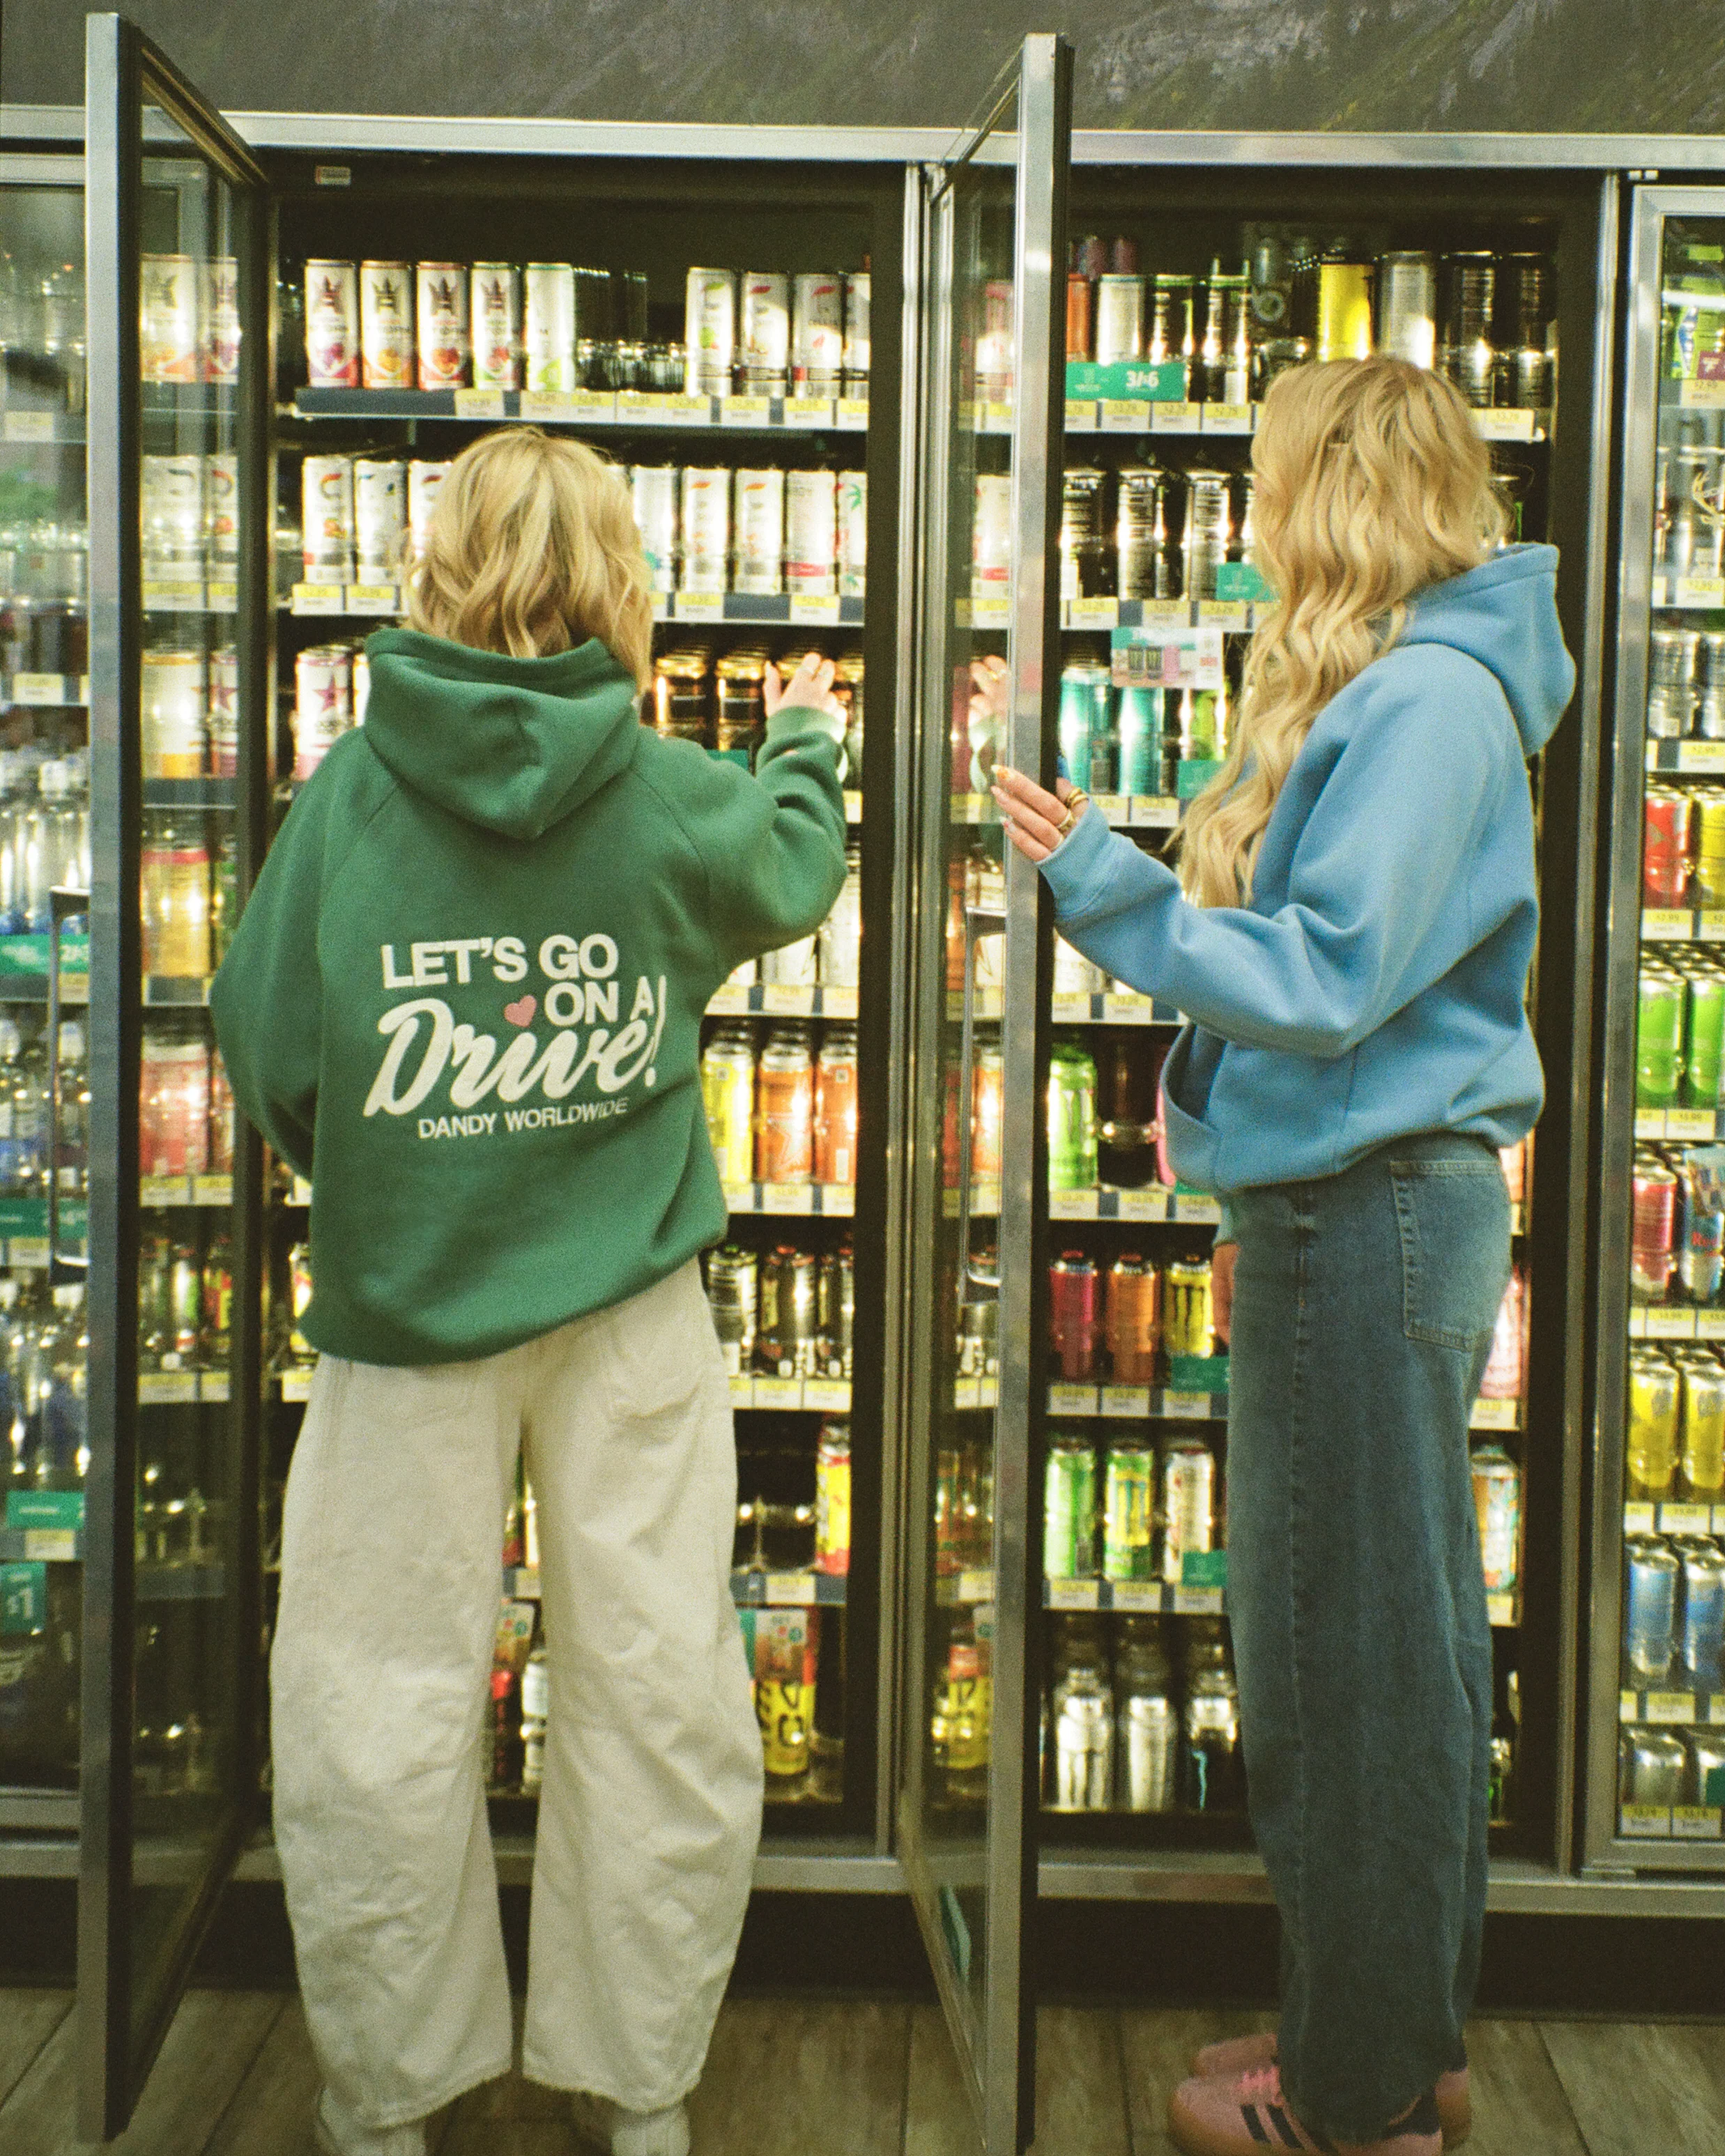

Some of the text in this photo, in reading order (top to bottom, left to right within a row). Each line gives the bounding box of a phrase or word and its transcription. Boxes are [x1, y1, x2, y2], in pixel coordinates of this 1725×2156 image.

[381, 933, 618, 989] LET'S GO
[544, 975, 654, 1026] ON A
[363, 974, 667, 1117] Drive!
[418, 1097, 629, 1139] DANDY WORLDWIDE
